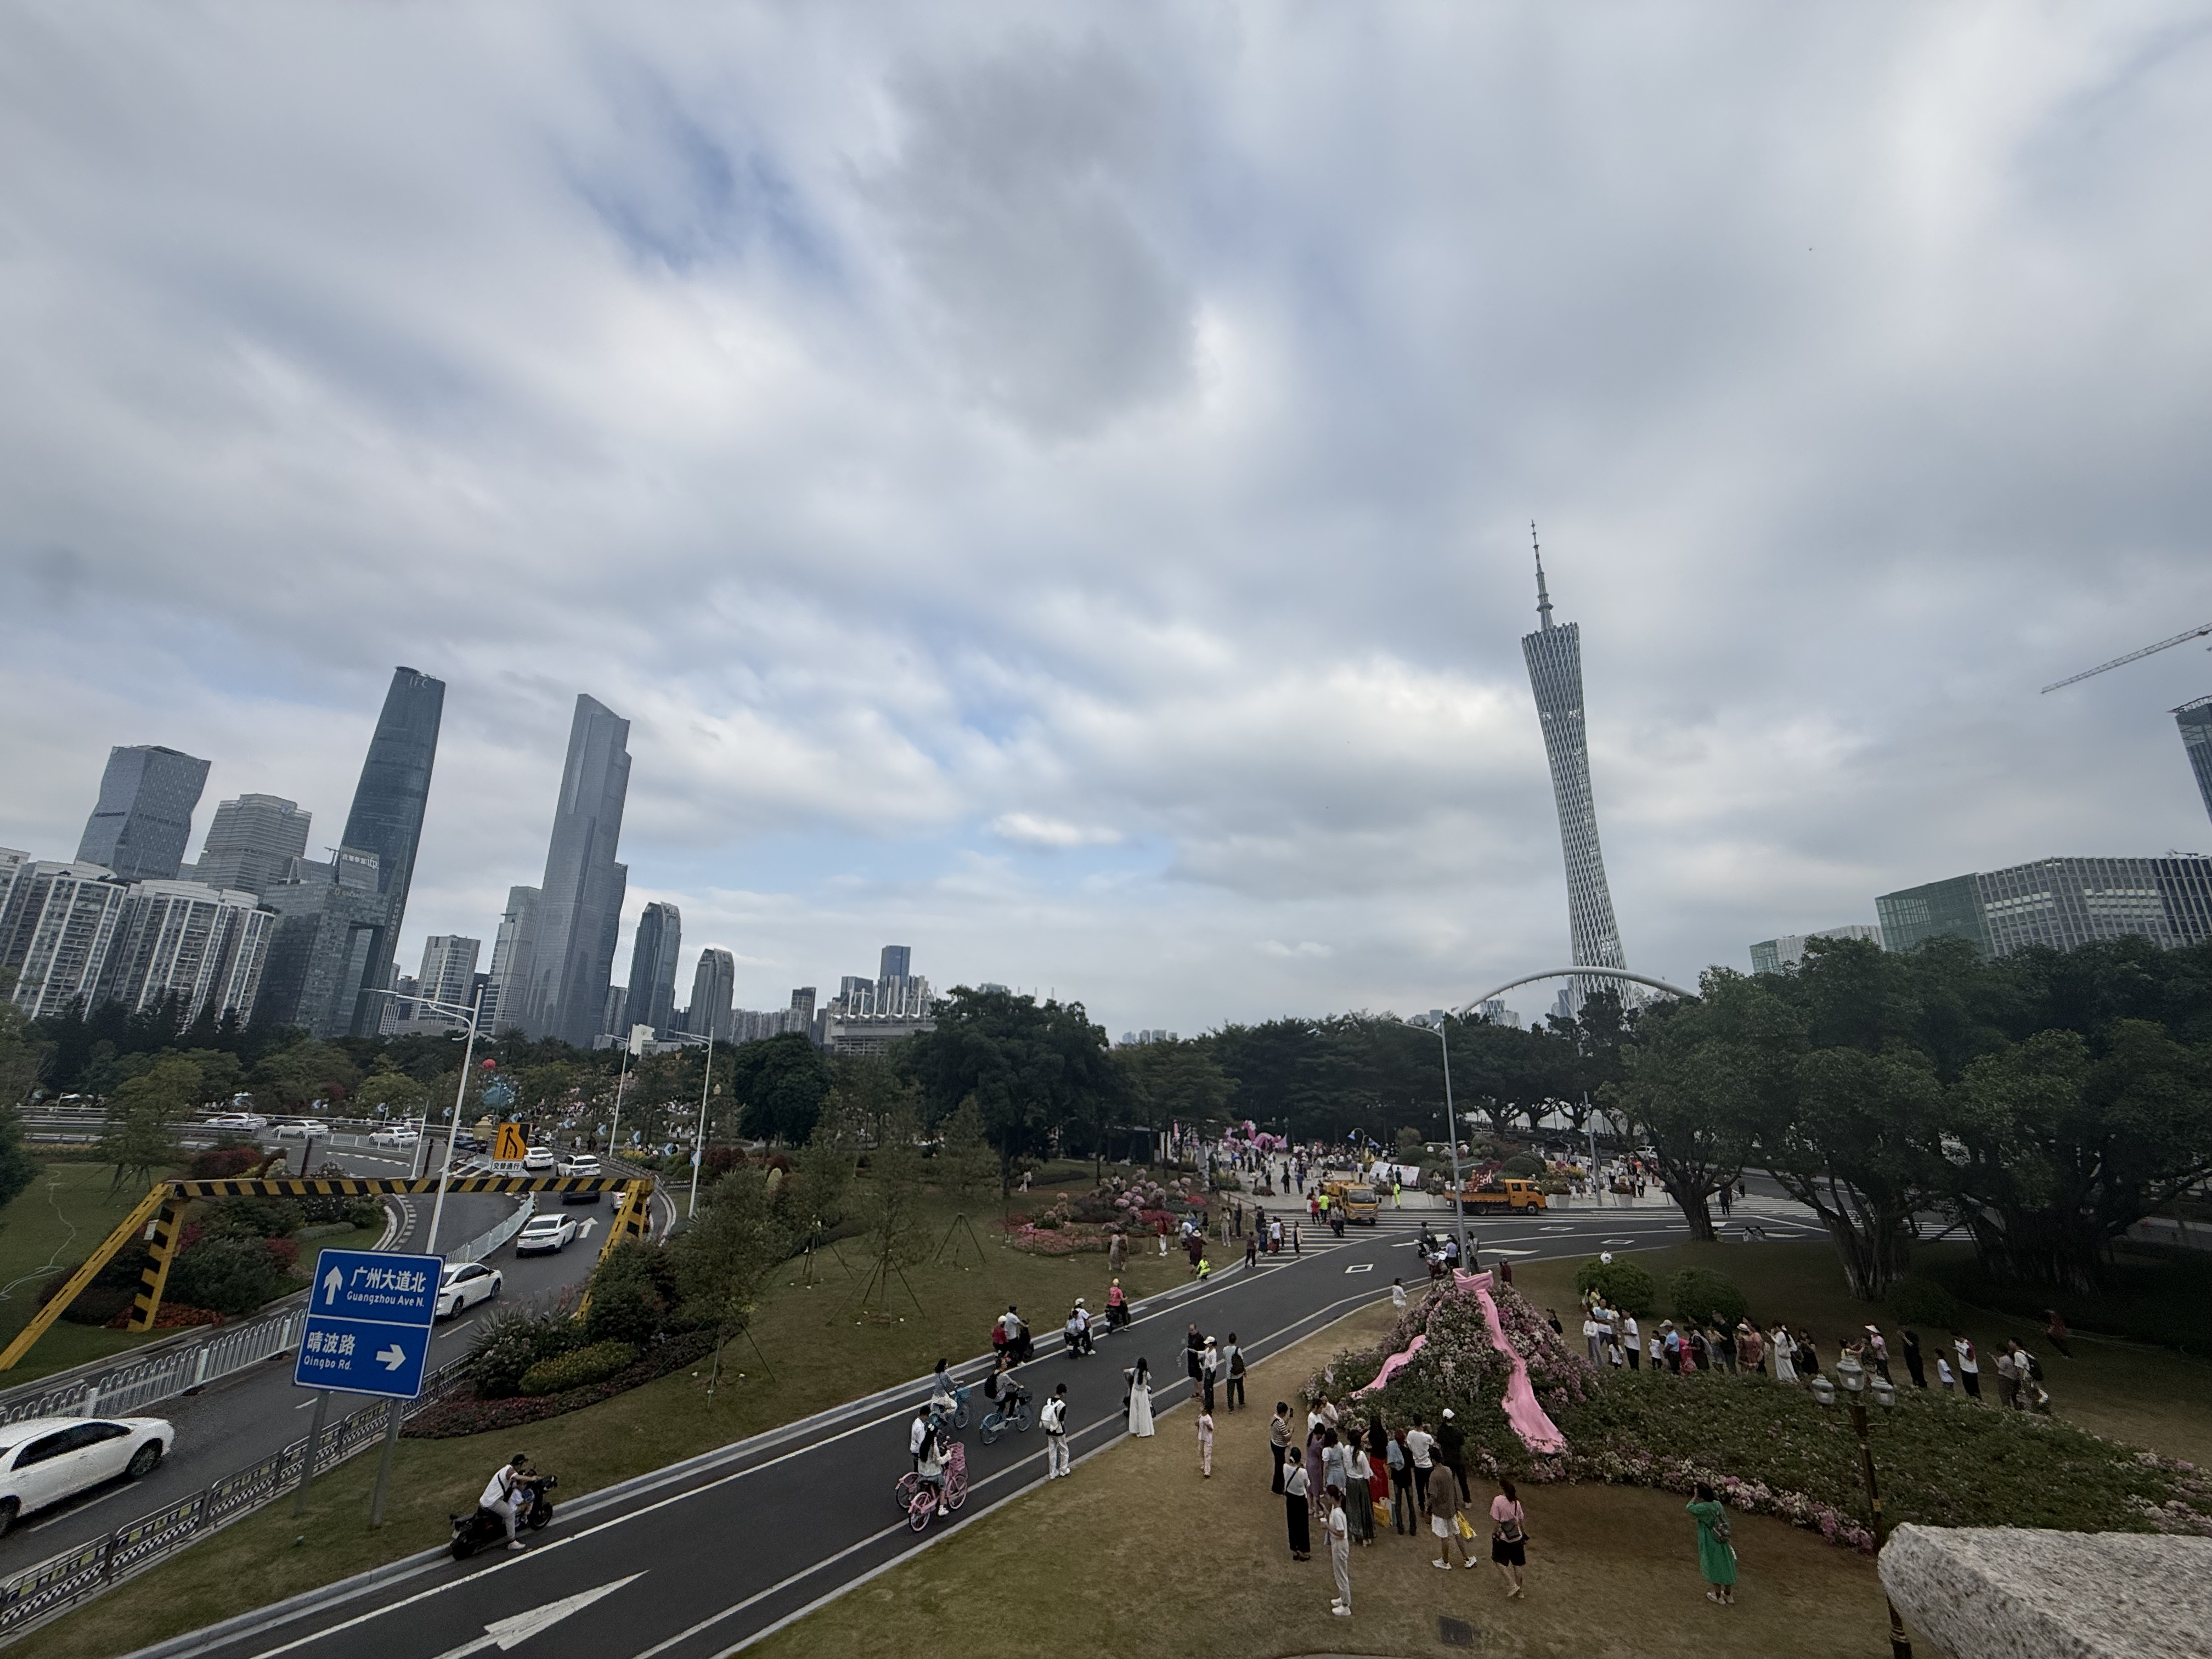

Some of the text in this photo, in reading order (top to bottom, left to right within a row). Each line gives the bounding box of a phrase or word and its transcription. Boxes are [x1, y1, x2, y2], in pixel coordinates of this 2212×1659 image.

[409, 675, 428, 689] IFC
[350, 1266, 427, 1293] 广州大道北
[347, 1291, 424, 1307] Guangzhou Ave N.
[306, 1331, 356, 1356] 晴波路
[303, 1355, 352, 1370] Qingbo Rd.
